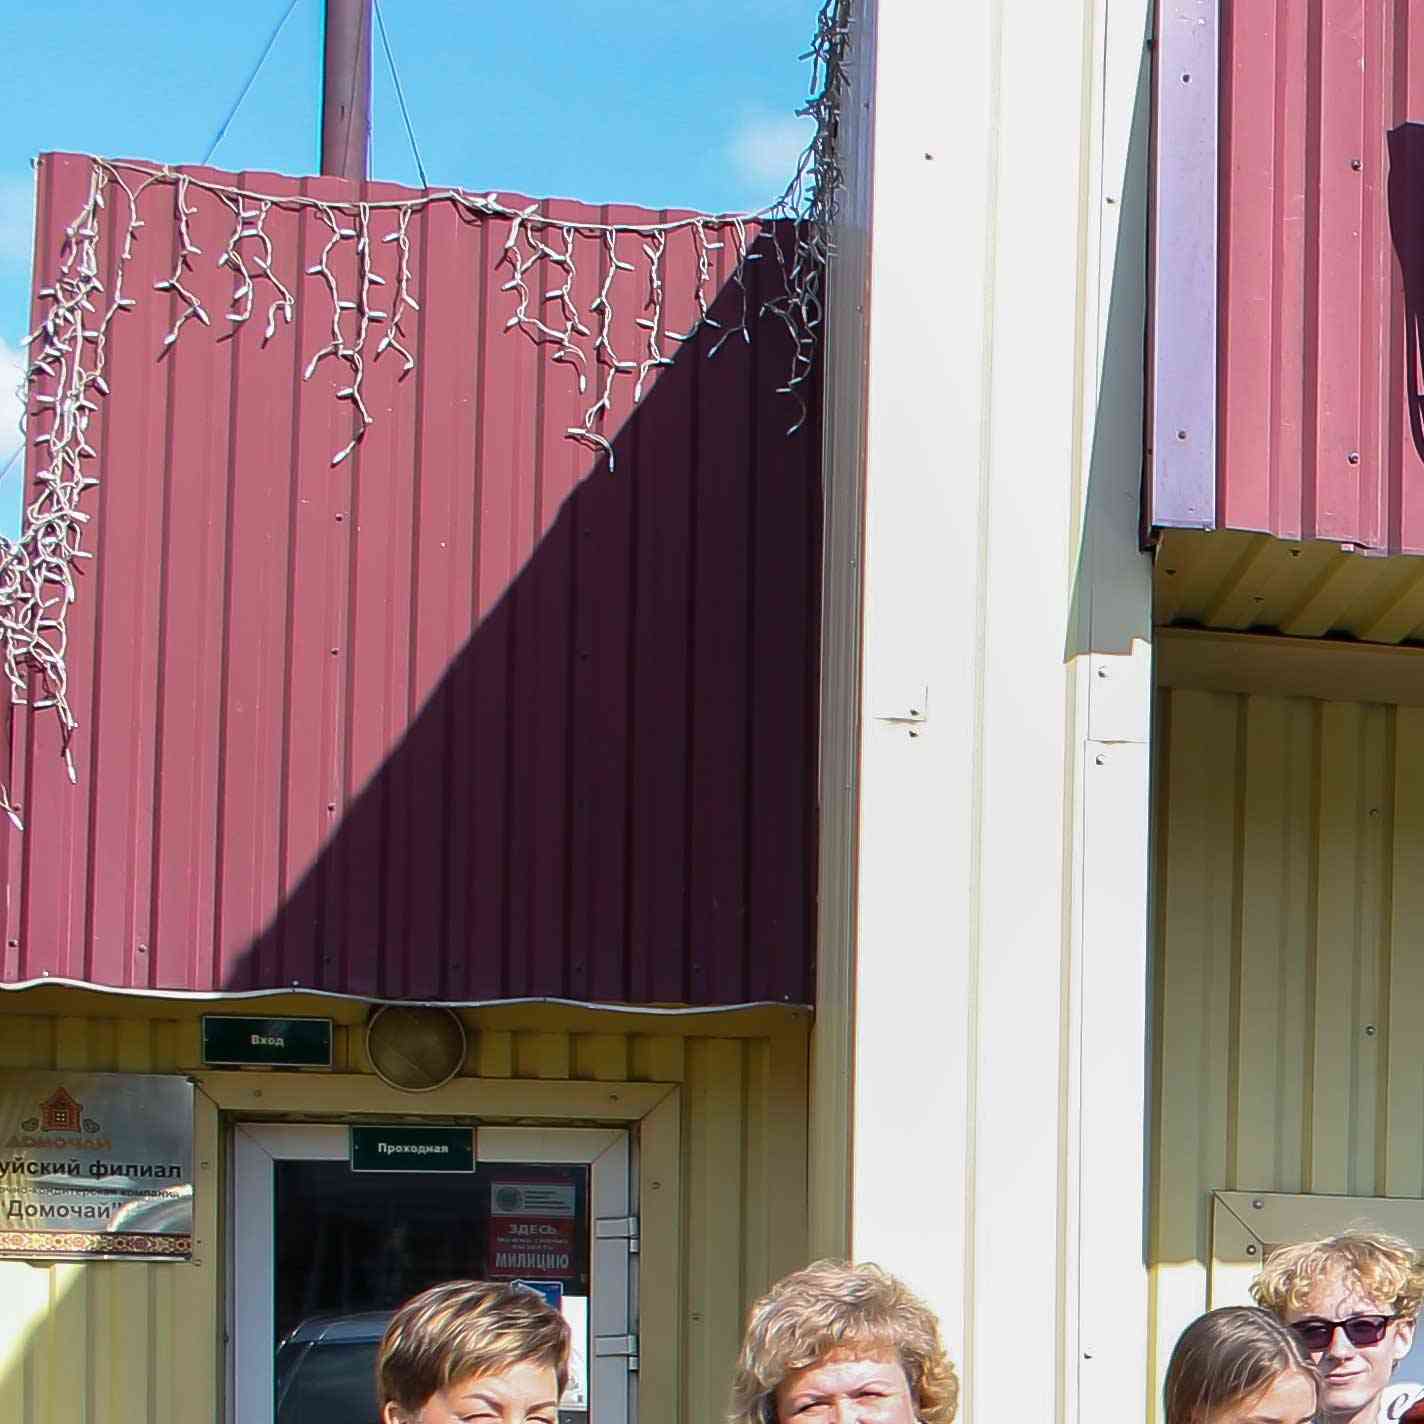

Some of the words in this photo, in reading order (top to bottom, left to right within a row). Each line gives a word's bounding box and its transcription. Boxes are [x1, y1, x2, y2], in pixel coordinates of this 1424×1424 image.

[251, 1034, 285, 1047] Вход
[378, 1142, 449, 1155] Проходная
[89, 1160, 181, 1179] филиал
[496, 1252, 569, 1271] МИЛИЦИЮ
